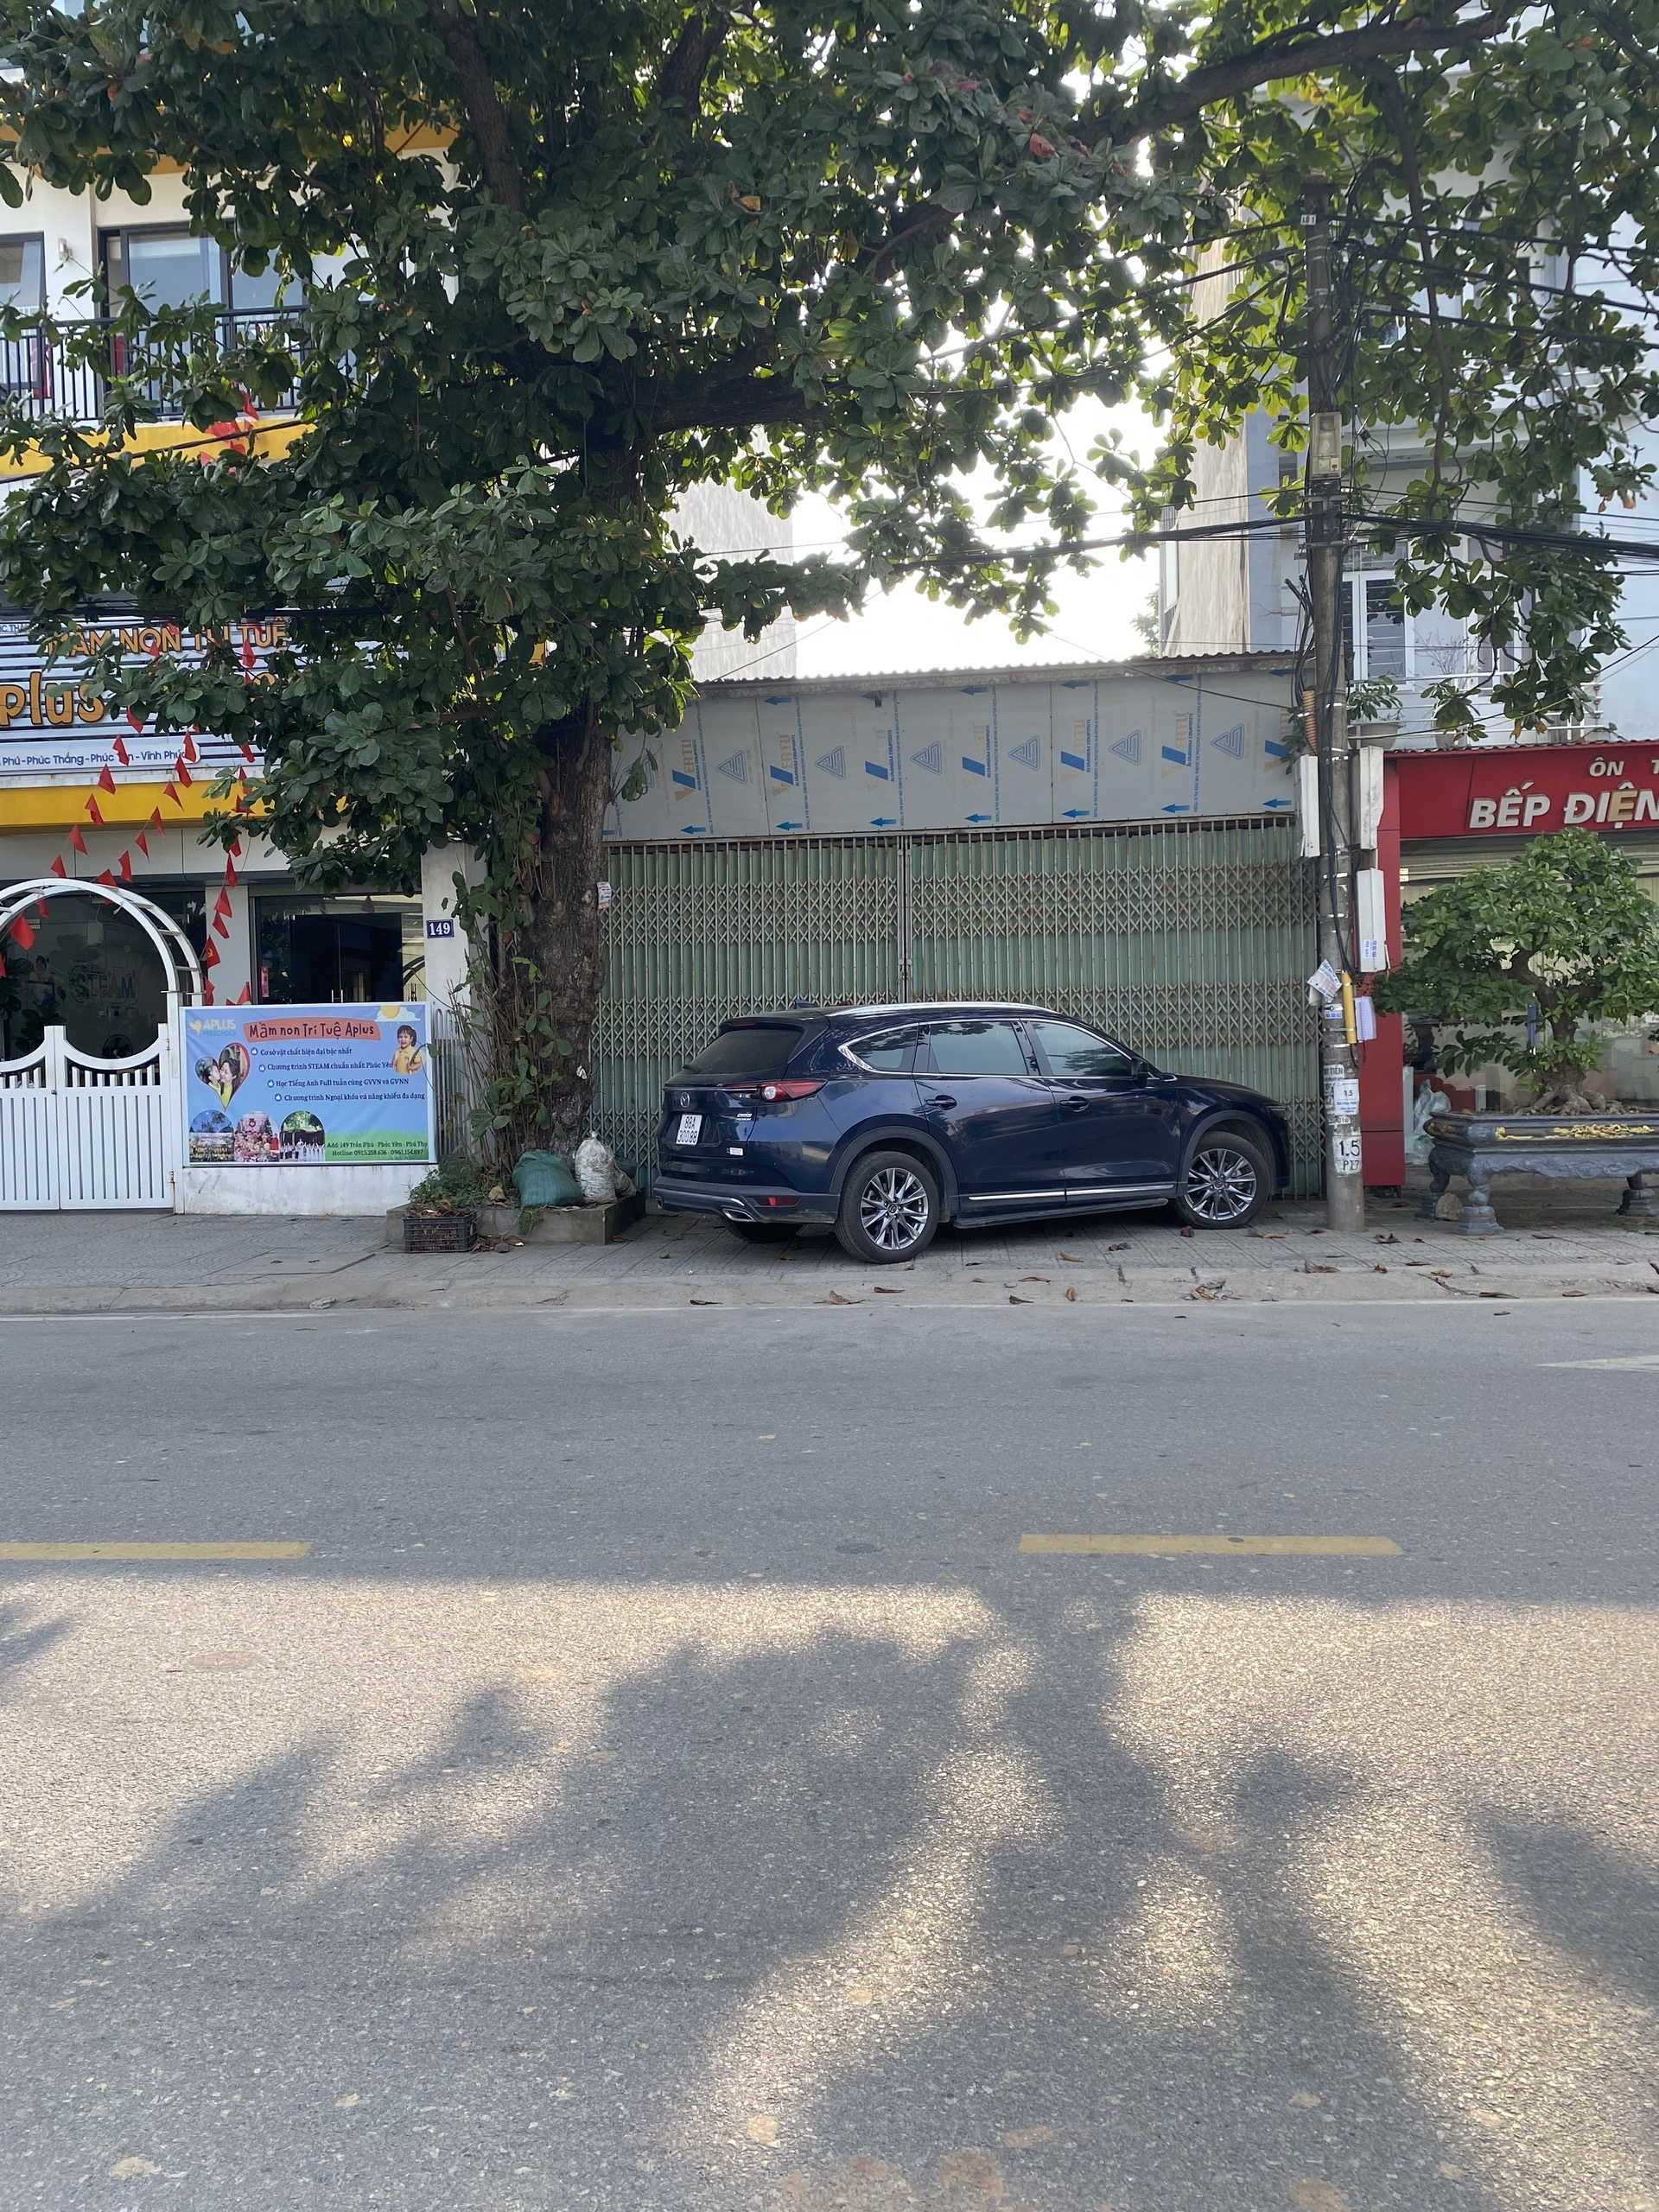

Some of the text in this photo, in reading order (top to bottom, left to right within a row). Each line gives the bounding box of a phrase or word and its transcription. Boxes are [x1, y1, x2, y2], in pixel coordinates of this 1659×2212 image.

[119, 626, 181, 654] NON
[3, 756, 21, 766] Phú
[27, 754, 50, 765] Phúc
[53, 752, 84, 766] Thắng
[91, 753, 114, 762] Phúc
[141, 750, 162, 760] Vĩnh
[1589, 757, 1624, 777] ÔN
[1470, 780, 1659, 829] BẾP ĐIỆN
[429, 922, 450, 936] 149
[203, 1019, 236, 1030] APLUS
[250, 1021, 374, 1039] Mầm non Trí Tuệ Aplus
[1339, 1140, 1360, 1157] 1.5
